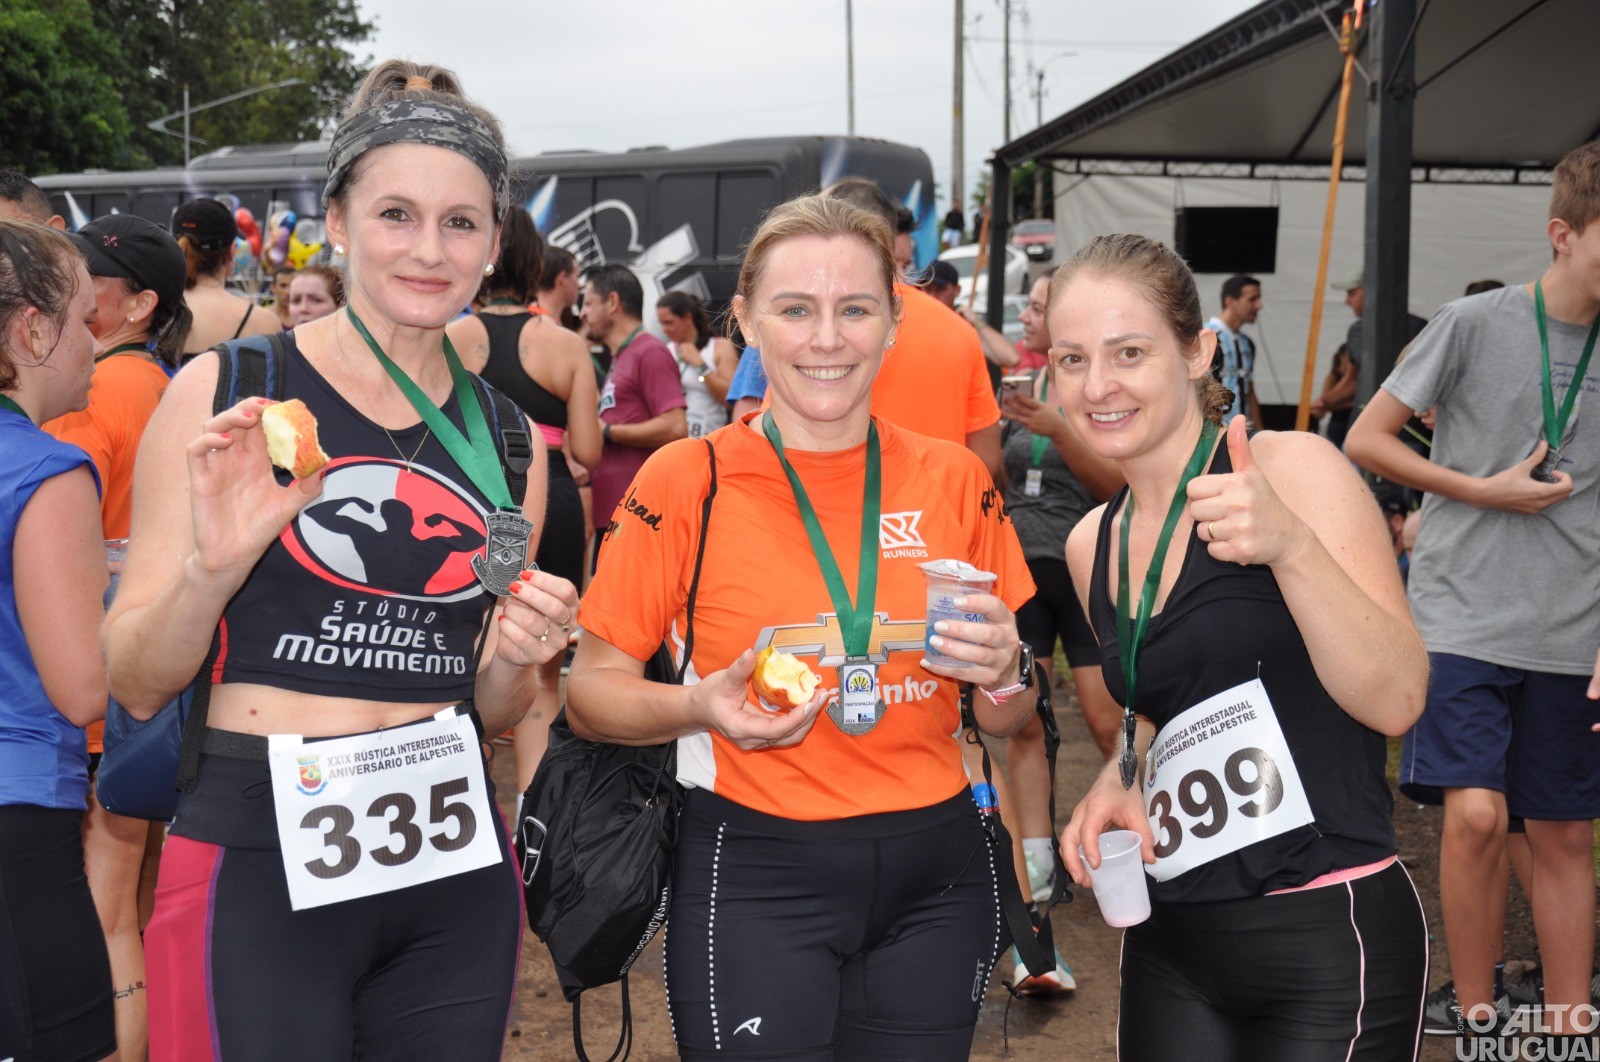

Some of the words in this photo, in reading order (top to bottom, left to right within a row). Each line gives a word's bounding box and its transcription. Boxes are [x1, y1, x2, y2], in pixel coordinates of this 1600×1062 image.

[624, 486, 662, 531] lead
[883, 548, 928, 560] RUNNERS
[333, 600, 436, 624] STÚDIO
[433, 633, 447, 650] E
[1189, 700, 1252, 734] INTERESTADUAL
[1197, 731, 1208, 743] DE
[1210, 710, 1257, 737] ALPESTRE
[327, 753, 352, 768] XXIX
[354, 746, 396, 762] RÚSTICA
[397, 732, 462, 755] INTERESTADUAL
[328, 757, 403, 780] ANIVERSÁRIO
[405, 753, 418, 765] DE
[419, 742, 466, 762] ALPESTRE
[1149, 747, 1284, 858] 399
[299, 777, 477, 879] 335
[971, 958, 985, 1002] GRIT
